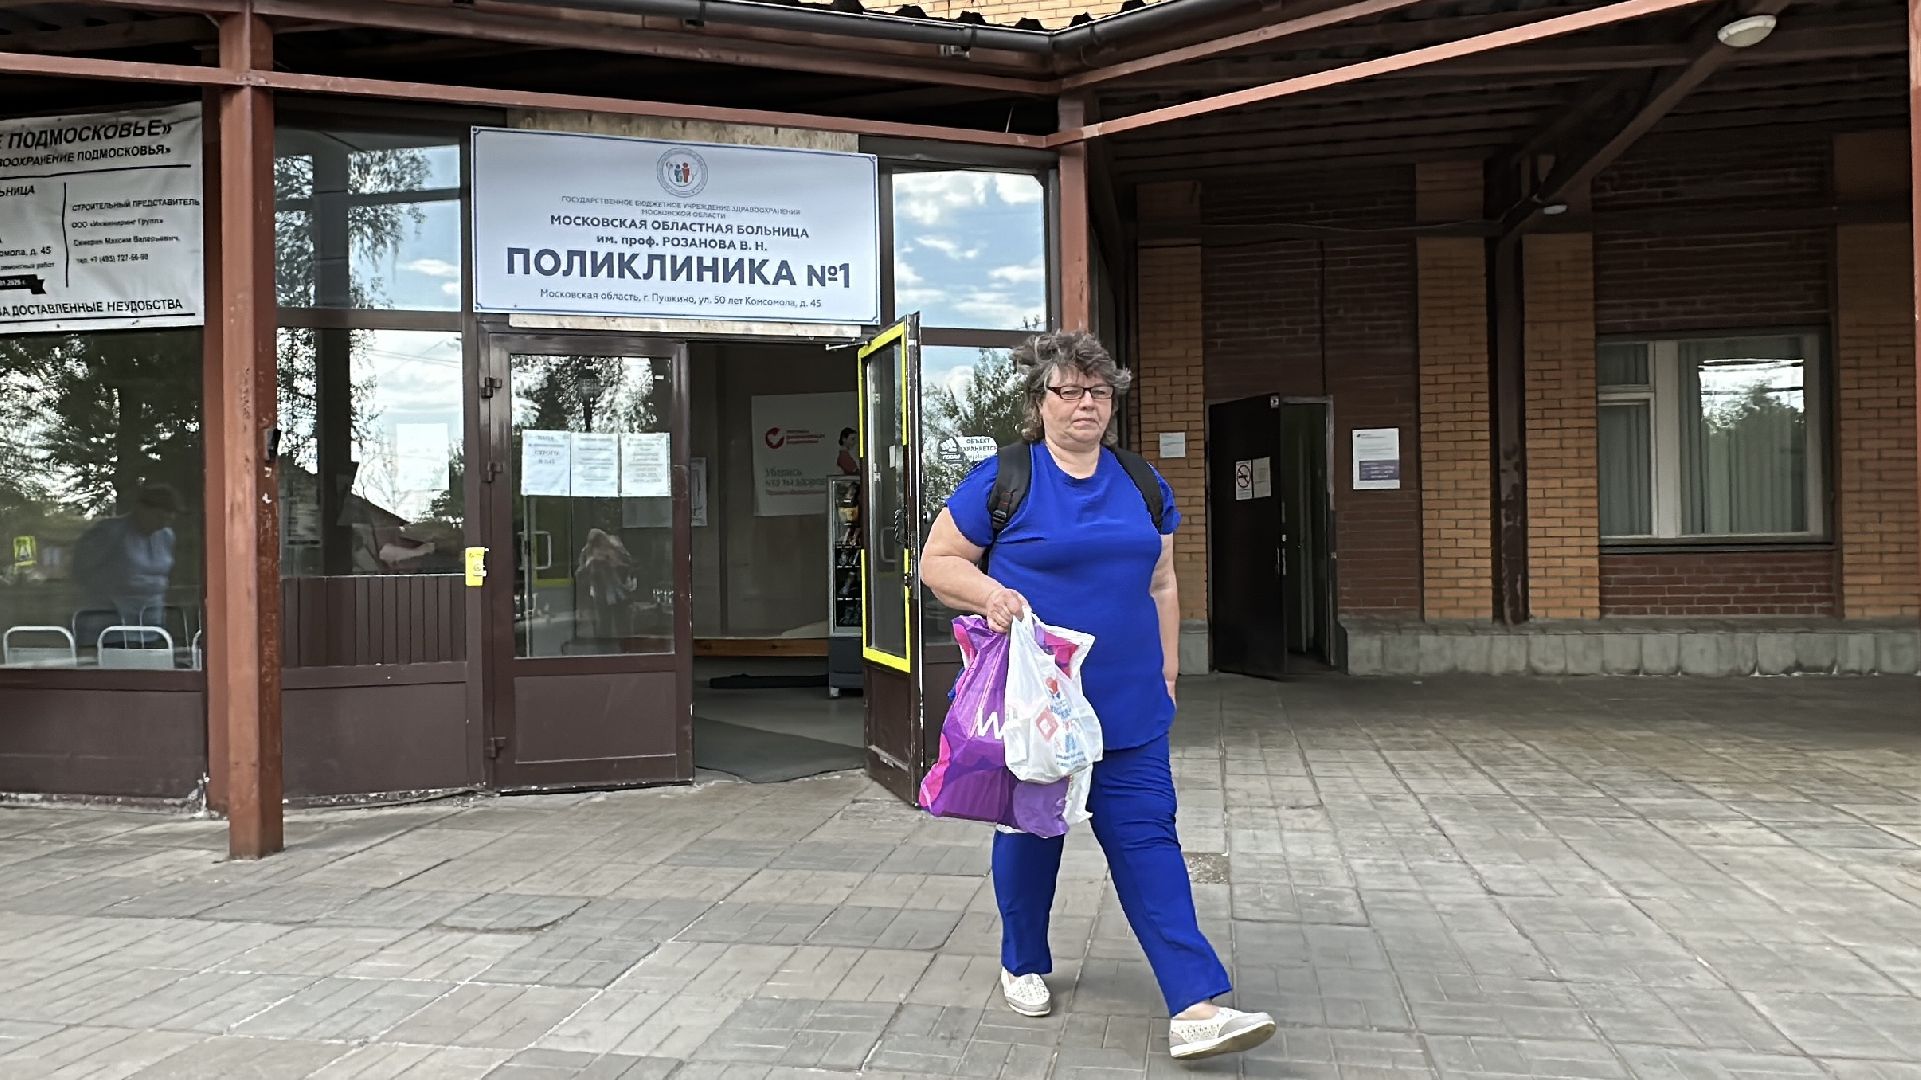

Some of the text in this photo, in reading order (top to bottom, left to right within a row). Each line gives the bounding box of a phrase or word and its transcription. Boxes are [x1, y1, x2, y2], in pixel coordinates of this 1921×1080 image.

[8, 119, 172, 150] ПОДМОСКОВЬЕ»
[77, 144, 171, 161] ПОДМОСКОВЬЯ»
[72, 198, 200, 212] СТРОИТЕЛЬНЫЙ ПРЕДСТАВИТЕЛЬ
[561, 195, 633, 207] ГОСУДАРСТВЕННОЕ
[635, 200, 682, 208] БЮДЖЕТНОЕ
[683, 203, 730, 212] УЧРЕЖДЕНИЕ
[641, 209, 726, 220] МОСКОВСКОЙ ОБЛАСТИ
[71, 221, 88, 229] ООО
[550, 214, 810, 240] МОСКОВСКАЯ ОБЛАСТНАЯ БОЛЬНИЦА
[40, 246, 52, 255] 45
[596, 236, 768, 252] им. проф. РОЗАНОВА В. Н.
[507, 247, 850, 289] ПОЛИКЛИНИКА №1
[540, 288, 822, 308] Московская область, г. Пушкино, ул. 50 лет Комсомола, д. 45
[12, 302, 104, 317] ДОСТАВЛЕННЫЕ
[107, 299, 183, 313] НЕУДОБСТВА
